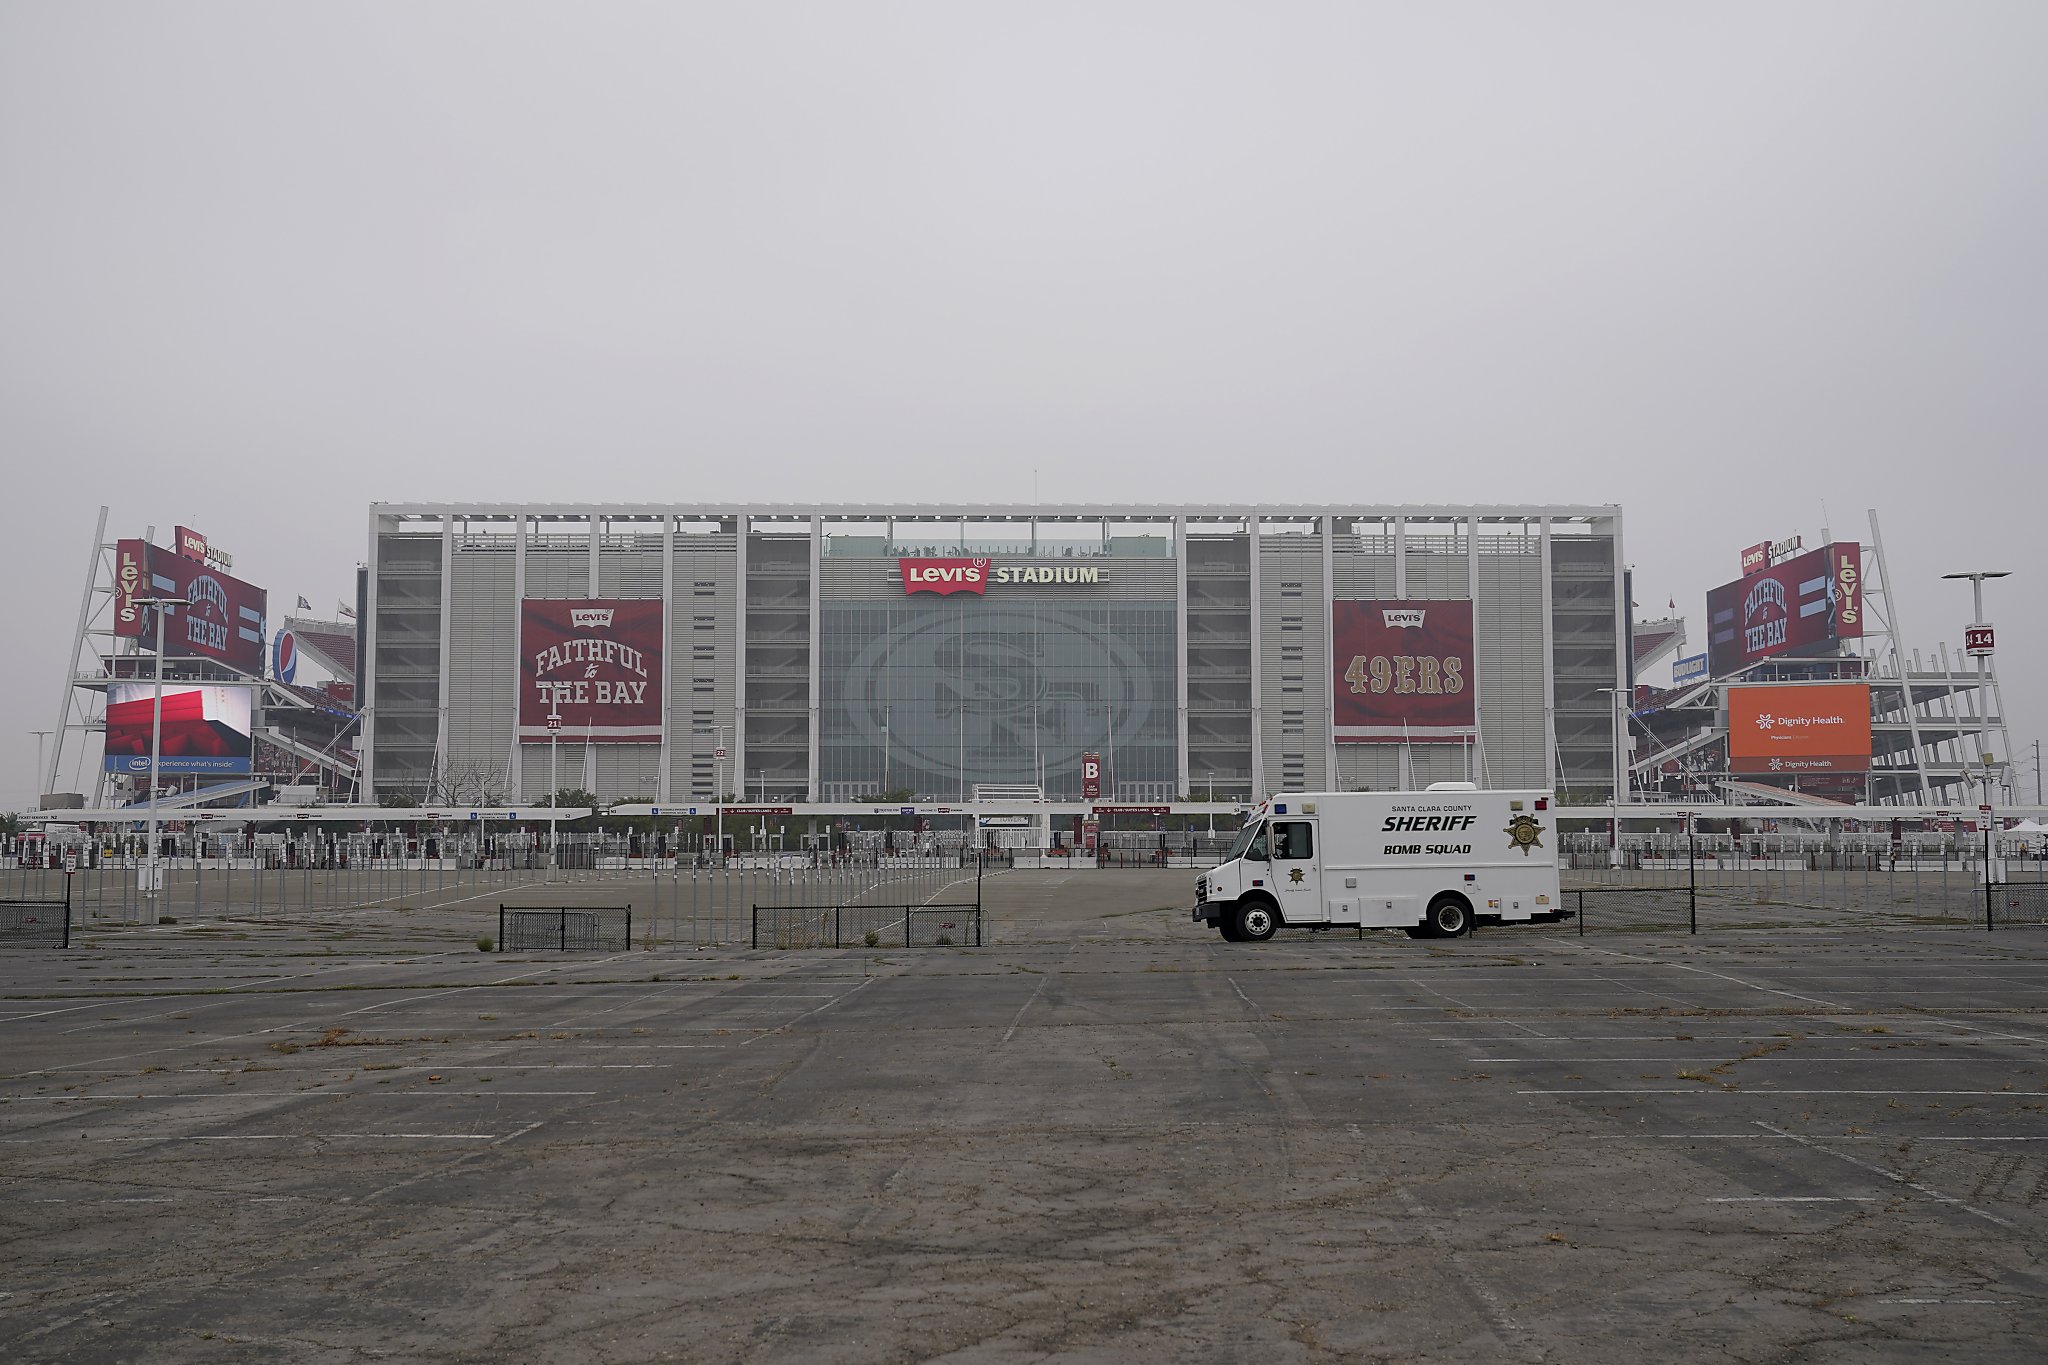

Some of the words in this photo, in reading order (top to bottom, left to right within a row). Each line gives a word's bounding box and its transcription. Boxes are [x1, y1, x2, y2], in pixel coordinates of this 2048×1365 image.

[184, 535, 205, 554] Levi's
[206, 546, 233, 566] STADIUM
[1743, 550, 1764, 568] Levi's
[1768, 536, 1798, 559] STADIUM
[910, 566, 981, 582] Levi's
[996, 566, 1099, 583] STADIUM
[120, 552, 139, 622] Levi's
[1839, 555, 1859, 624] Levi's
[187, 574, 229, 626] FAITHFUL
[1744, 577, 1787, 627] FAITHFUL
[576, 613, 609, 621] Levi's
[1388, 614, 1421, 622] Levi's
[186, 614, 207, 646] THE
[208, 622, 228, 652] BAY
[1745, 624, 1766, 653] THE
[1767, 617, 1787, 647] BAY
[1975, 633, 1993, 644] 14
[535, 638, 648, 678] FAITHFUL
[583, 663, 599, 679] to
[1344, 655, 1464, 695] 49ERS
[535, 681, 589, 704] THE
[595, 681, 648, 704] BAY
[548, 720, 558, 728] 21
[1778, 716, 1811, 727] Dignity
[1812, 715, 1843, 725] Health
[131, 759, 148, 767] intel
[157, 760, 190, 768] xperience
[190, 760, 212, 768] what's
[1085, 762, 1099, 779] B
[1785, 760, 1809, 769] Dignity
[1809, 760, 1832, 768] Health
[1381, 815, 1478, 832] SHERIFF
[1383, 844, 1422, 855] BOMB
[1425, 844, 1472, 855] SQUAD
